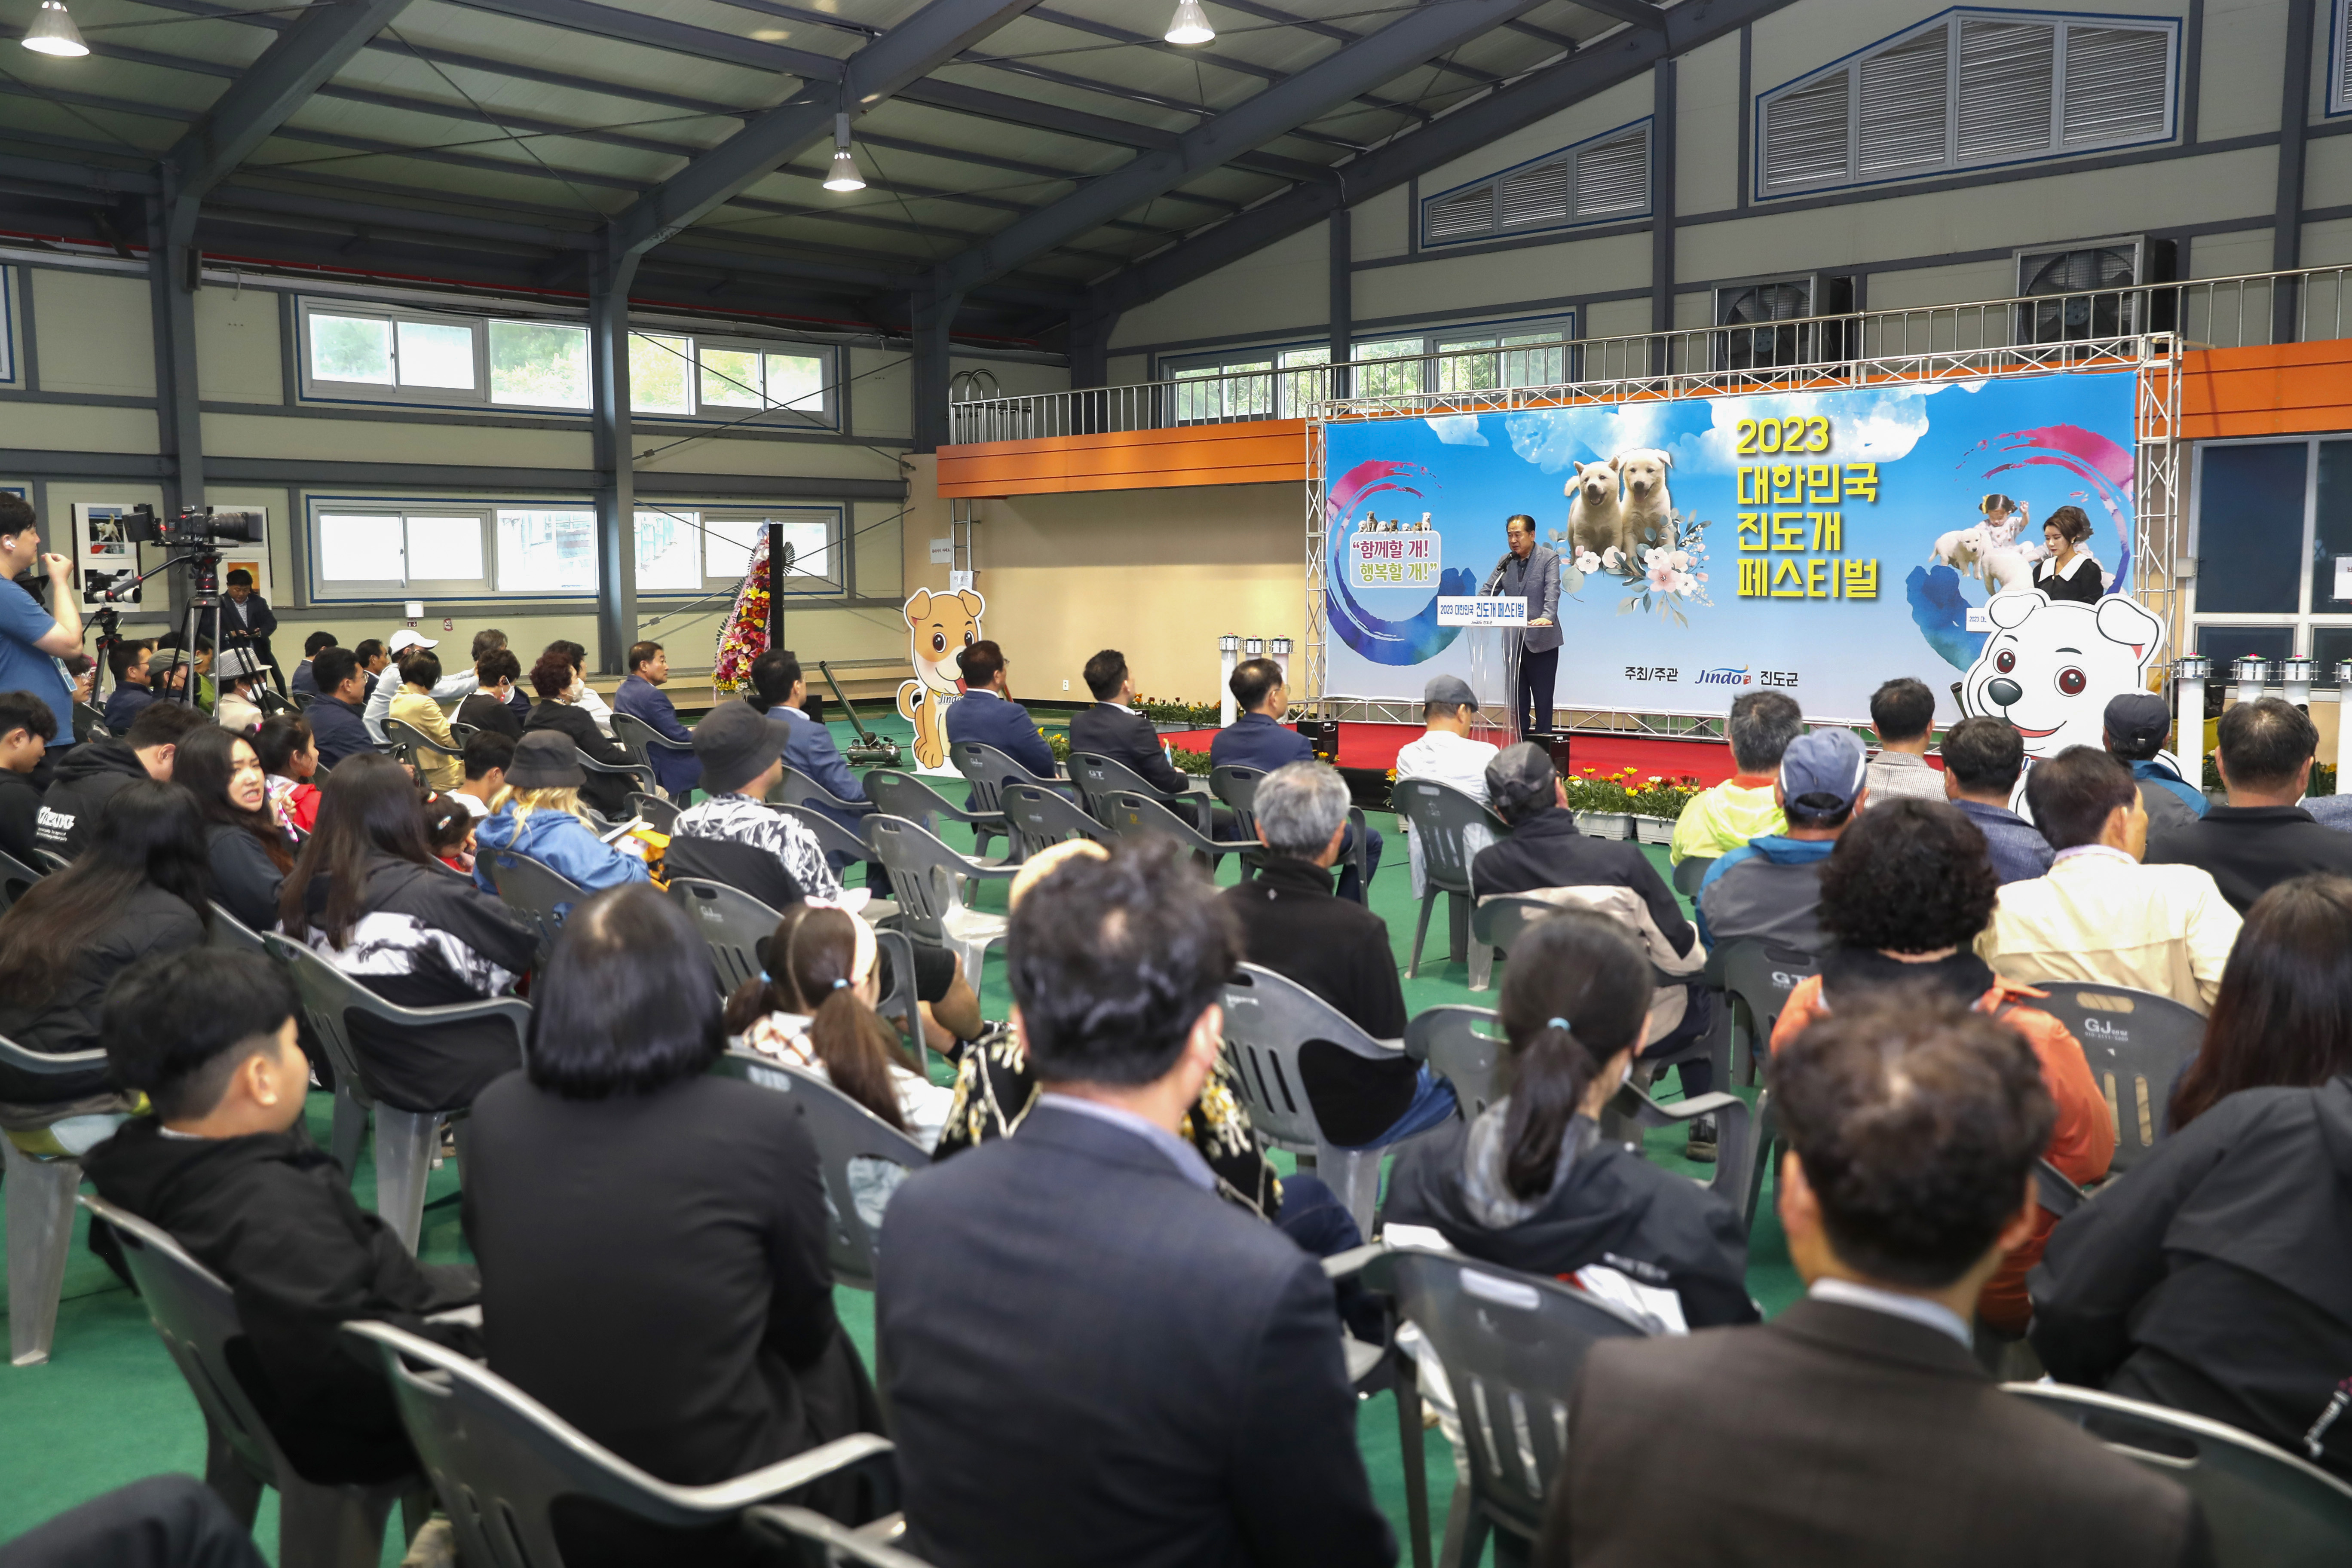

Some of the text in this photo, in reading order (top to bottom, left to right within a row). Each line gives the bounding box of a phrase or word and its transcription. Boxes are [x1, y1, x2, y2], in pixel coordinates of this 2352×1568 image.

[1736, 415, 1829, 453] 2023
[1737, 462, 1878, 504] 대한민국
[1737, 511, 1840, 551] 진도개
[1408, 539, 1428, 558] 개!
[1360, 562, 1403, 582] 행복할
[1737, 558, 1877, 597] 페스티벌
[1440, 603, 1524, 618] 2023 대한민국 진도개 페스티벌
[1625, 666, 1678, 682] 주최/주관
[1695, 670, 1742, 685] Jindo
[1761, 671, 1799, 687] 진도군
